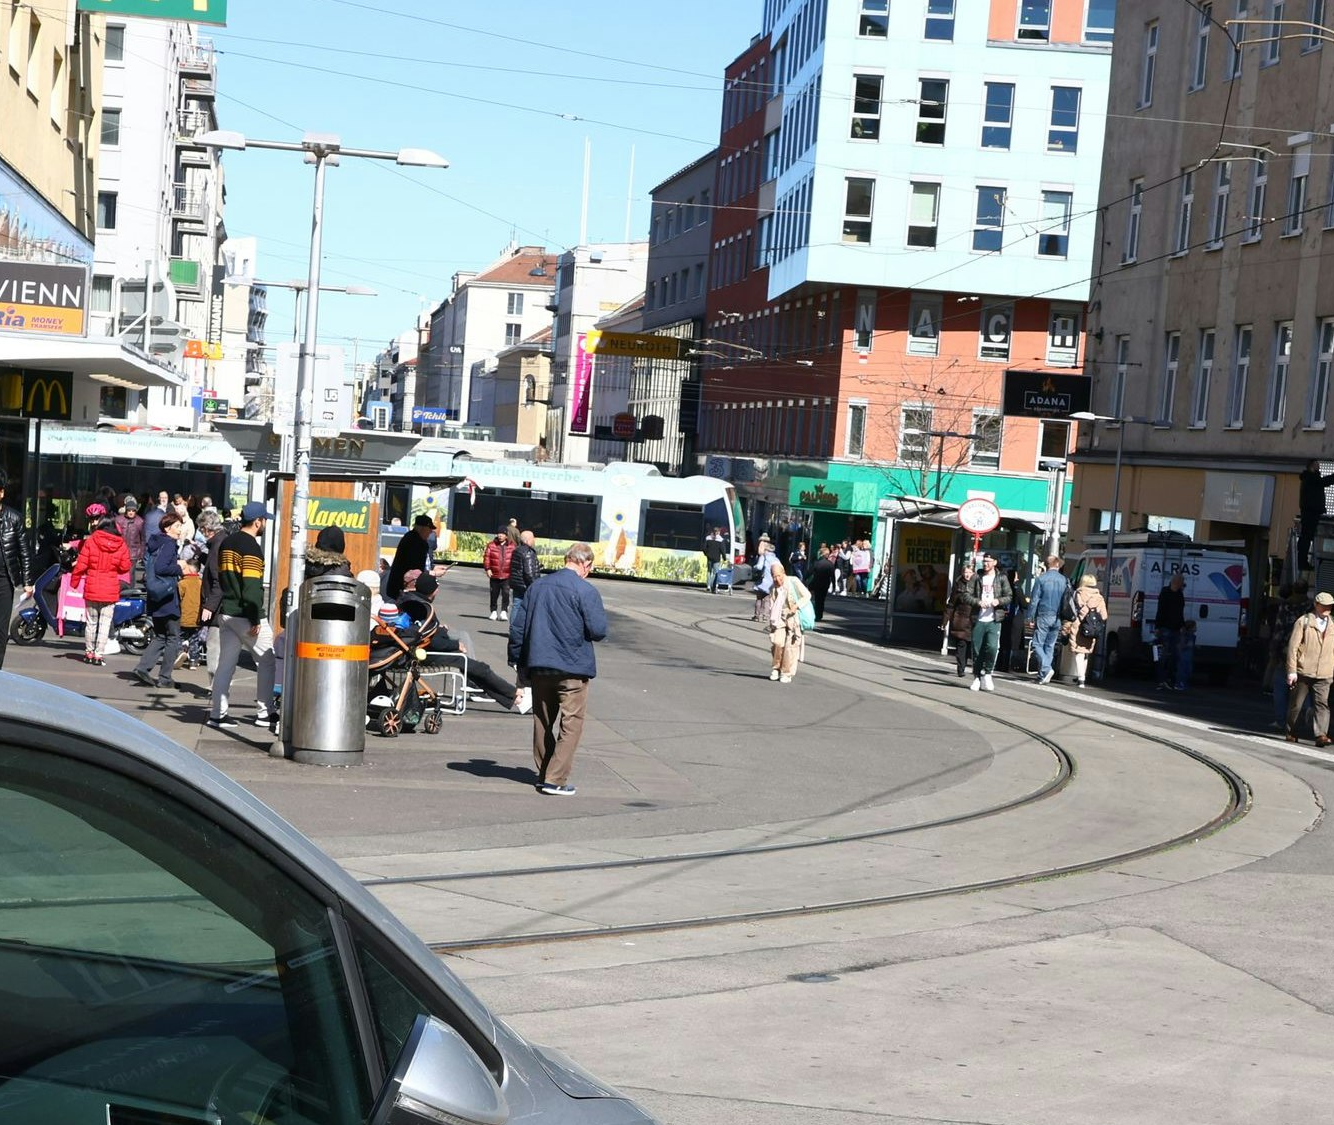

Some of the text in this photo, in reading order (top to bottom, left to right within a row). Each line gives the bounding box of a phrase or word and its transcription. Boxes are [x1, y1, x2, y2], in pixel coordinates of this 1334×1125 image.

[31, 317, 64, 325] MONEY
[211, 294, 223, 344] HUMANIC
[610, 338, 671, 352] NEUROTH
[1029, 396, 1066, 406] ADANA
